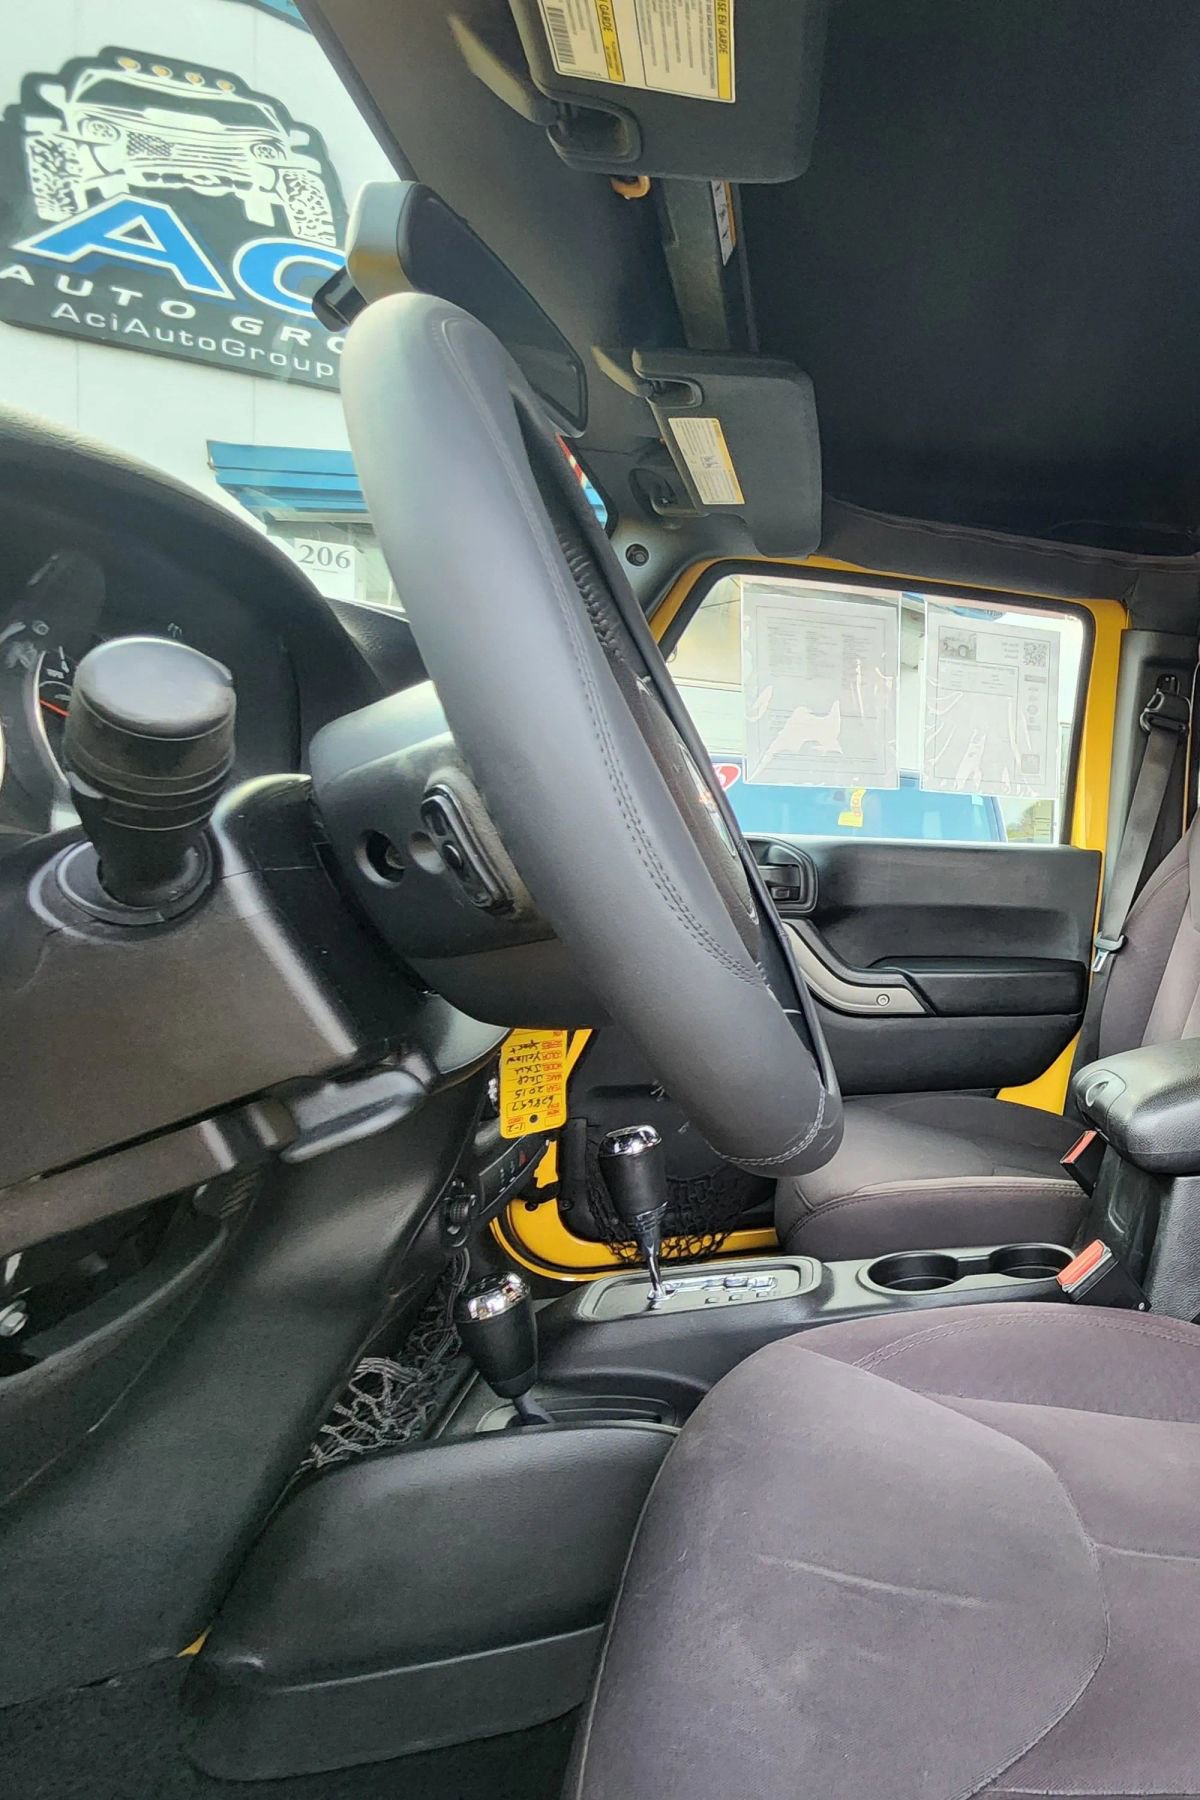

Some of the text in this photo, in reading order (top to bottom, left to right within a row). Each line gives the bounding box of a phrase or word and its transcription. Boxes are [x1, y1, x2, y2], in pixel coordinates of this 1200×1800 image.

[599, 4, 613, 32] GARDE
[717, 14, 727, 26] EN
[718, 28, 728, 54] GARDE
[0, 263, 196, 320] AUTO
[298, 544, 351, 569] 206
[505, 1050, 541, 1064] Yellow
[514, 1085, 544, 1098] 2015
